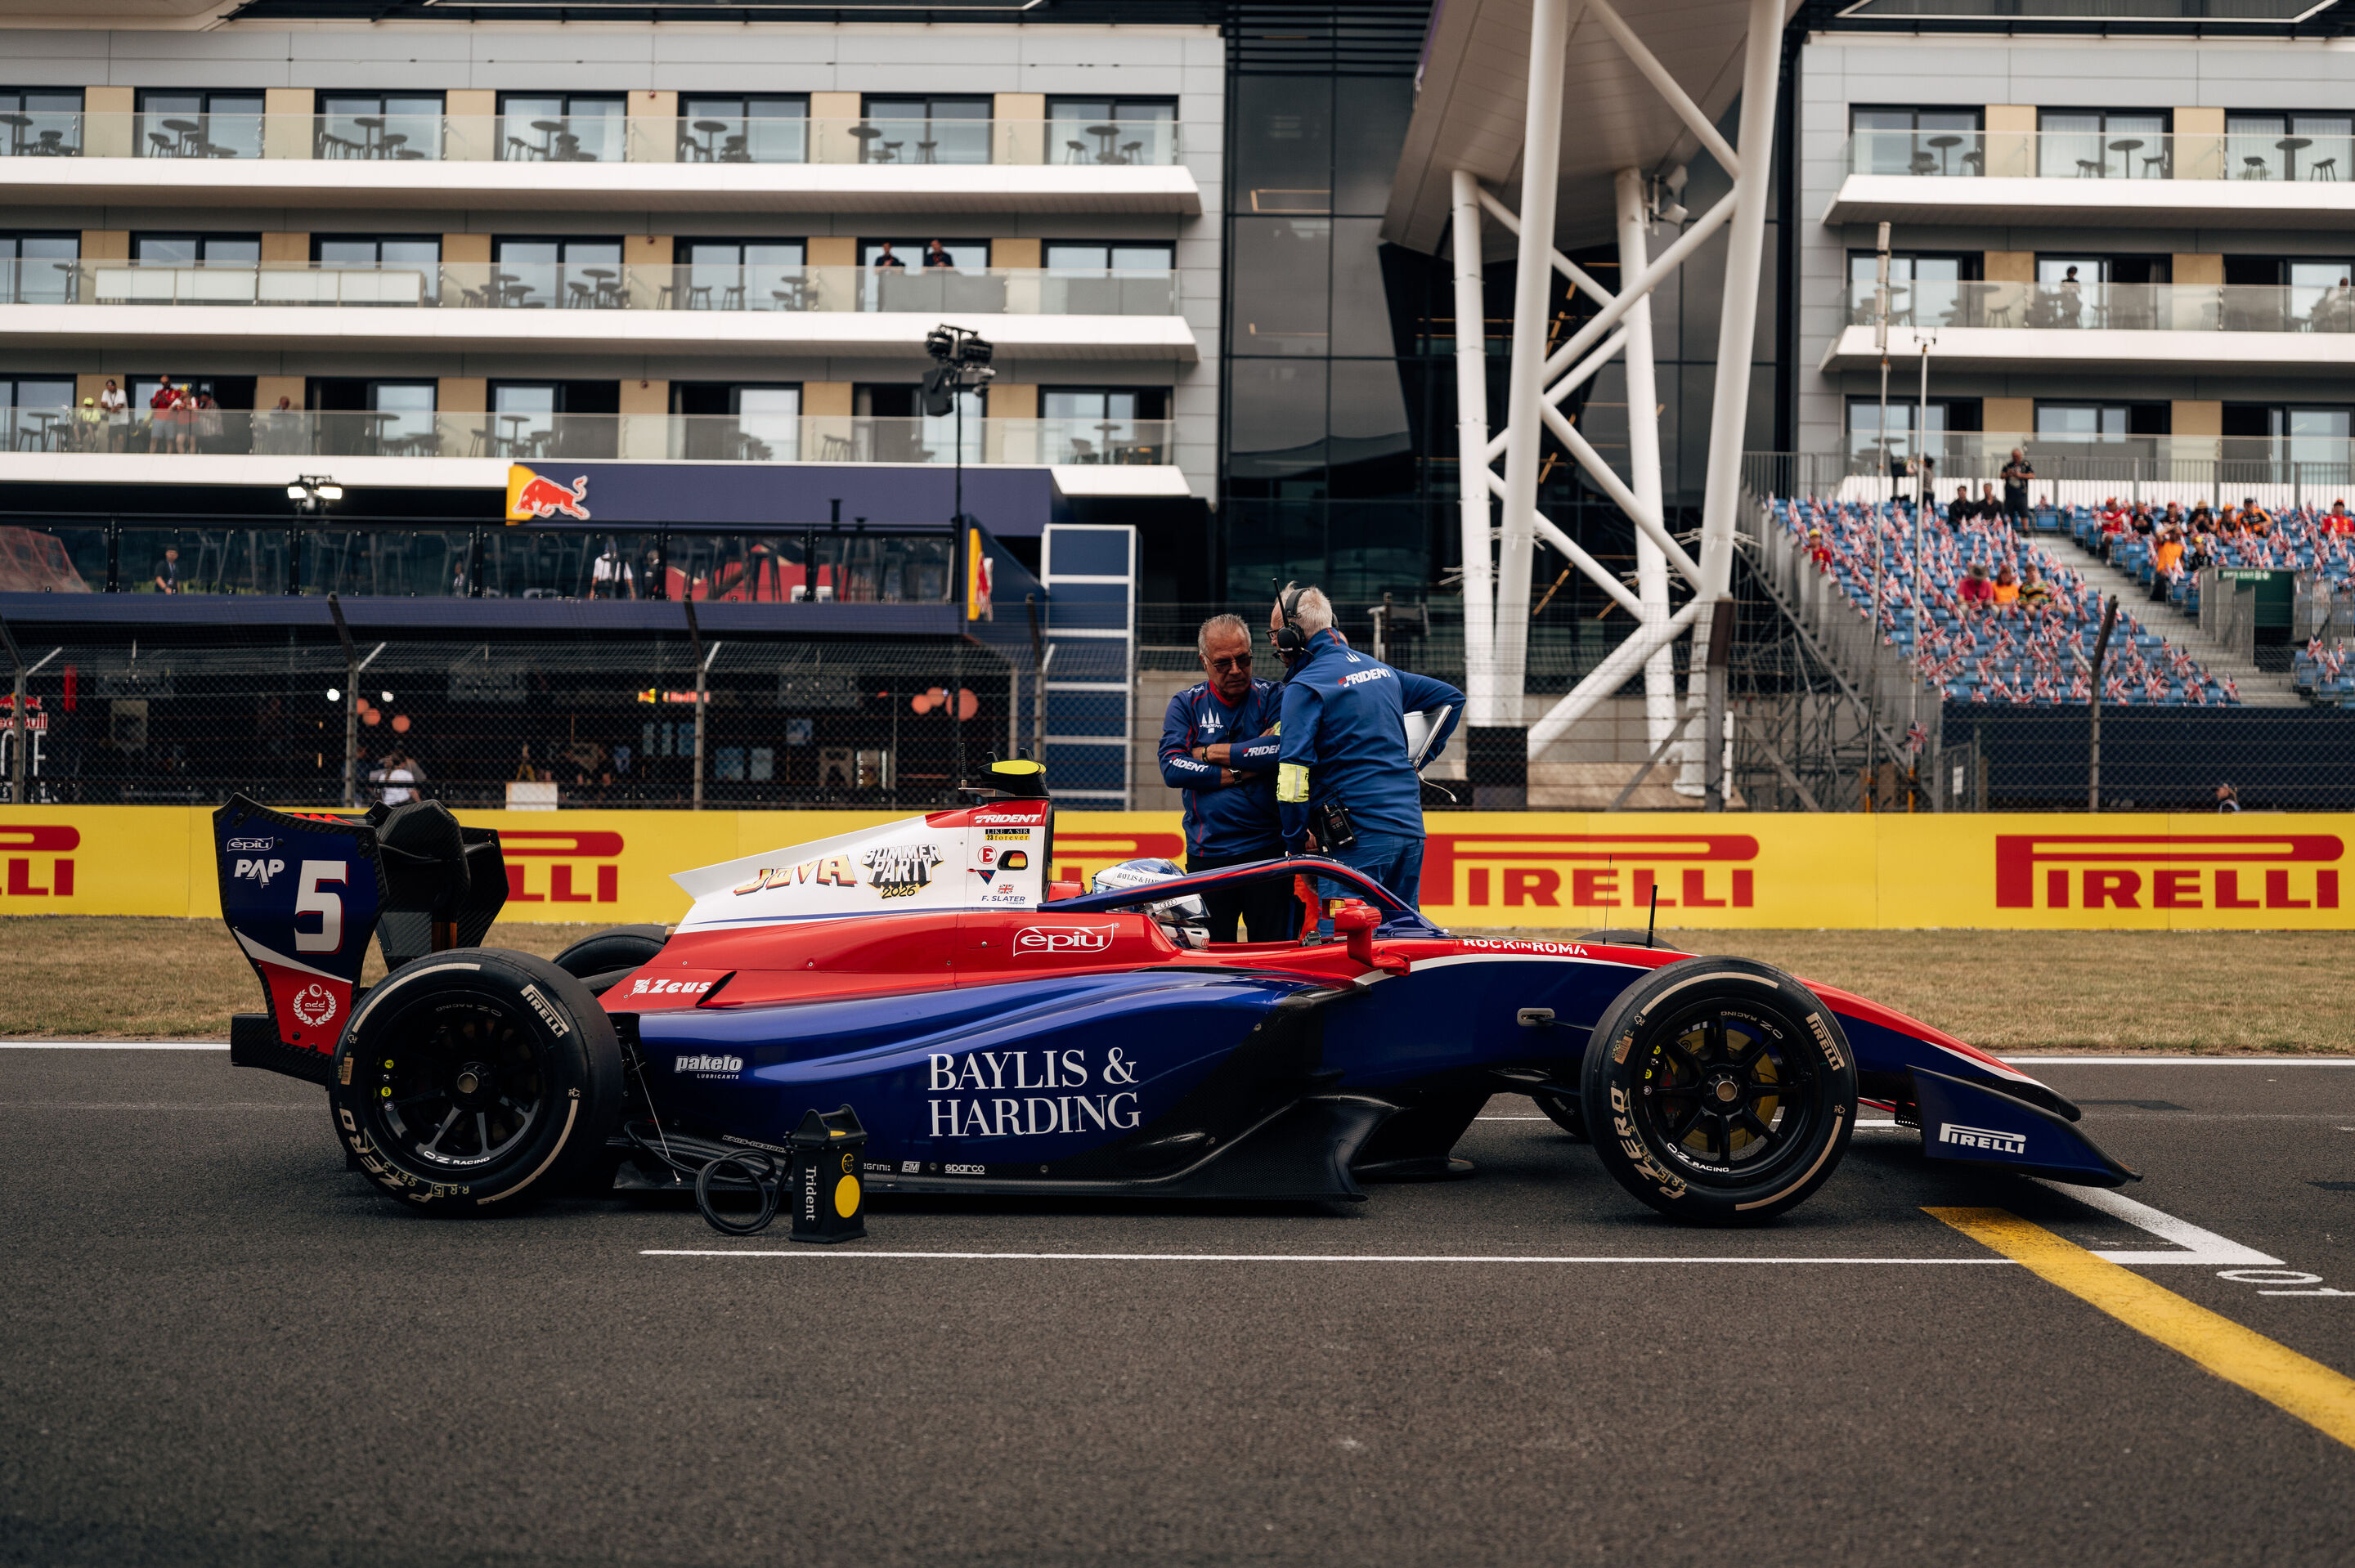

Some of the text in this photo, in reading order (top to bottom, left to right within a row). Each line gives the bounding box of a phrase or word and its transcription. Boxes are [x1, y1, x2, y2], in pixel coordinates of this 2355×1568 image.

[1339, 667, 1391, 688] TRIDENT
[975, 814, 1042, 824] TRIDENT
[862, 844, 944, 865] SUMMER
[733, 854, 858, 896] JOVA
[870, 857, 932, 885] PARTY
[1117, 872, 1137, 881] BAYLIS
[1419, 834, 1759, 907] PIRELLI
[1996, 835, 2344, 908] PIRELLI
[882, 885, 917, 899] 2026
[294, 860, 348, 954] 5
[648, 979, 712, 994] Zeus
[520, 983, 570, 1038] PIRELLI
[1806, 1012, 1846, 1071] PIRELLI
[675, 1055, 743, 1073] pakelo
[928, 1046, 1139, 1091] BAYLIS &
[928, 1091, 1142, 1137] HARDING
[1939, 1122, 2026, 1154] PIRELLI
[452, 1156, 491, 1165] RACING
[944, 1163, 985, 1175] sparco
[1692, 1161, 1729, 1172] RACING
[805, 1165, 817, 1221] Trident
